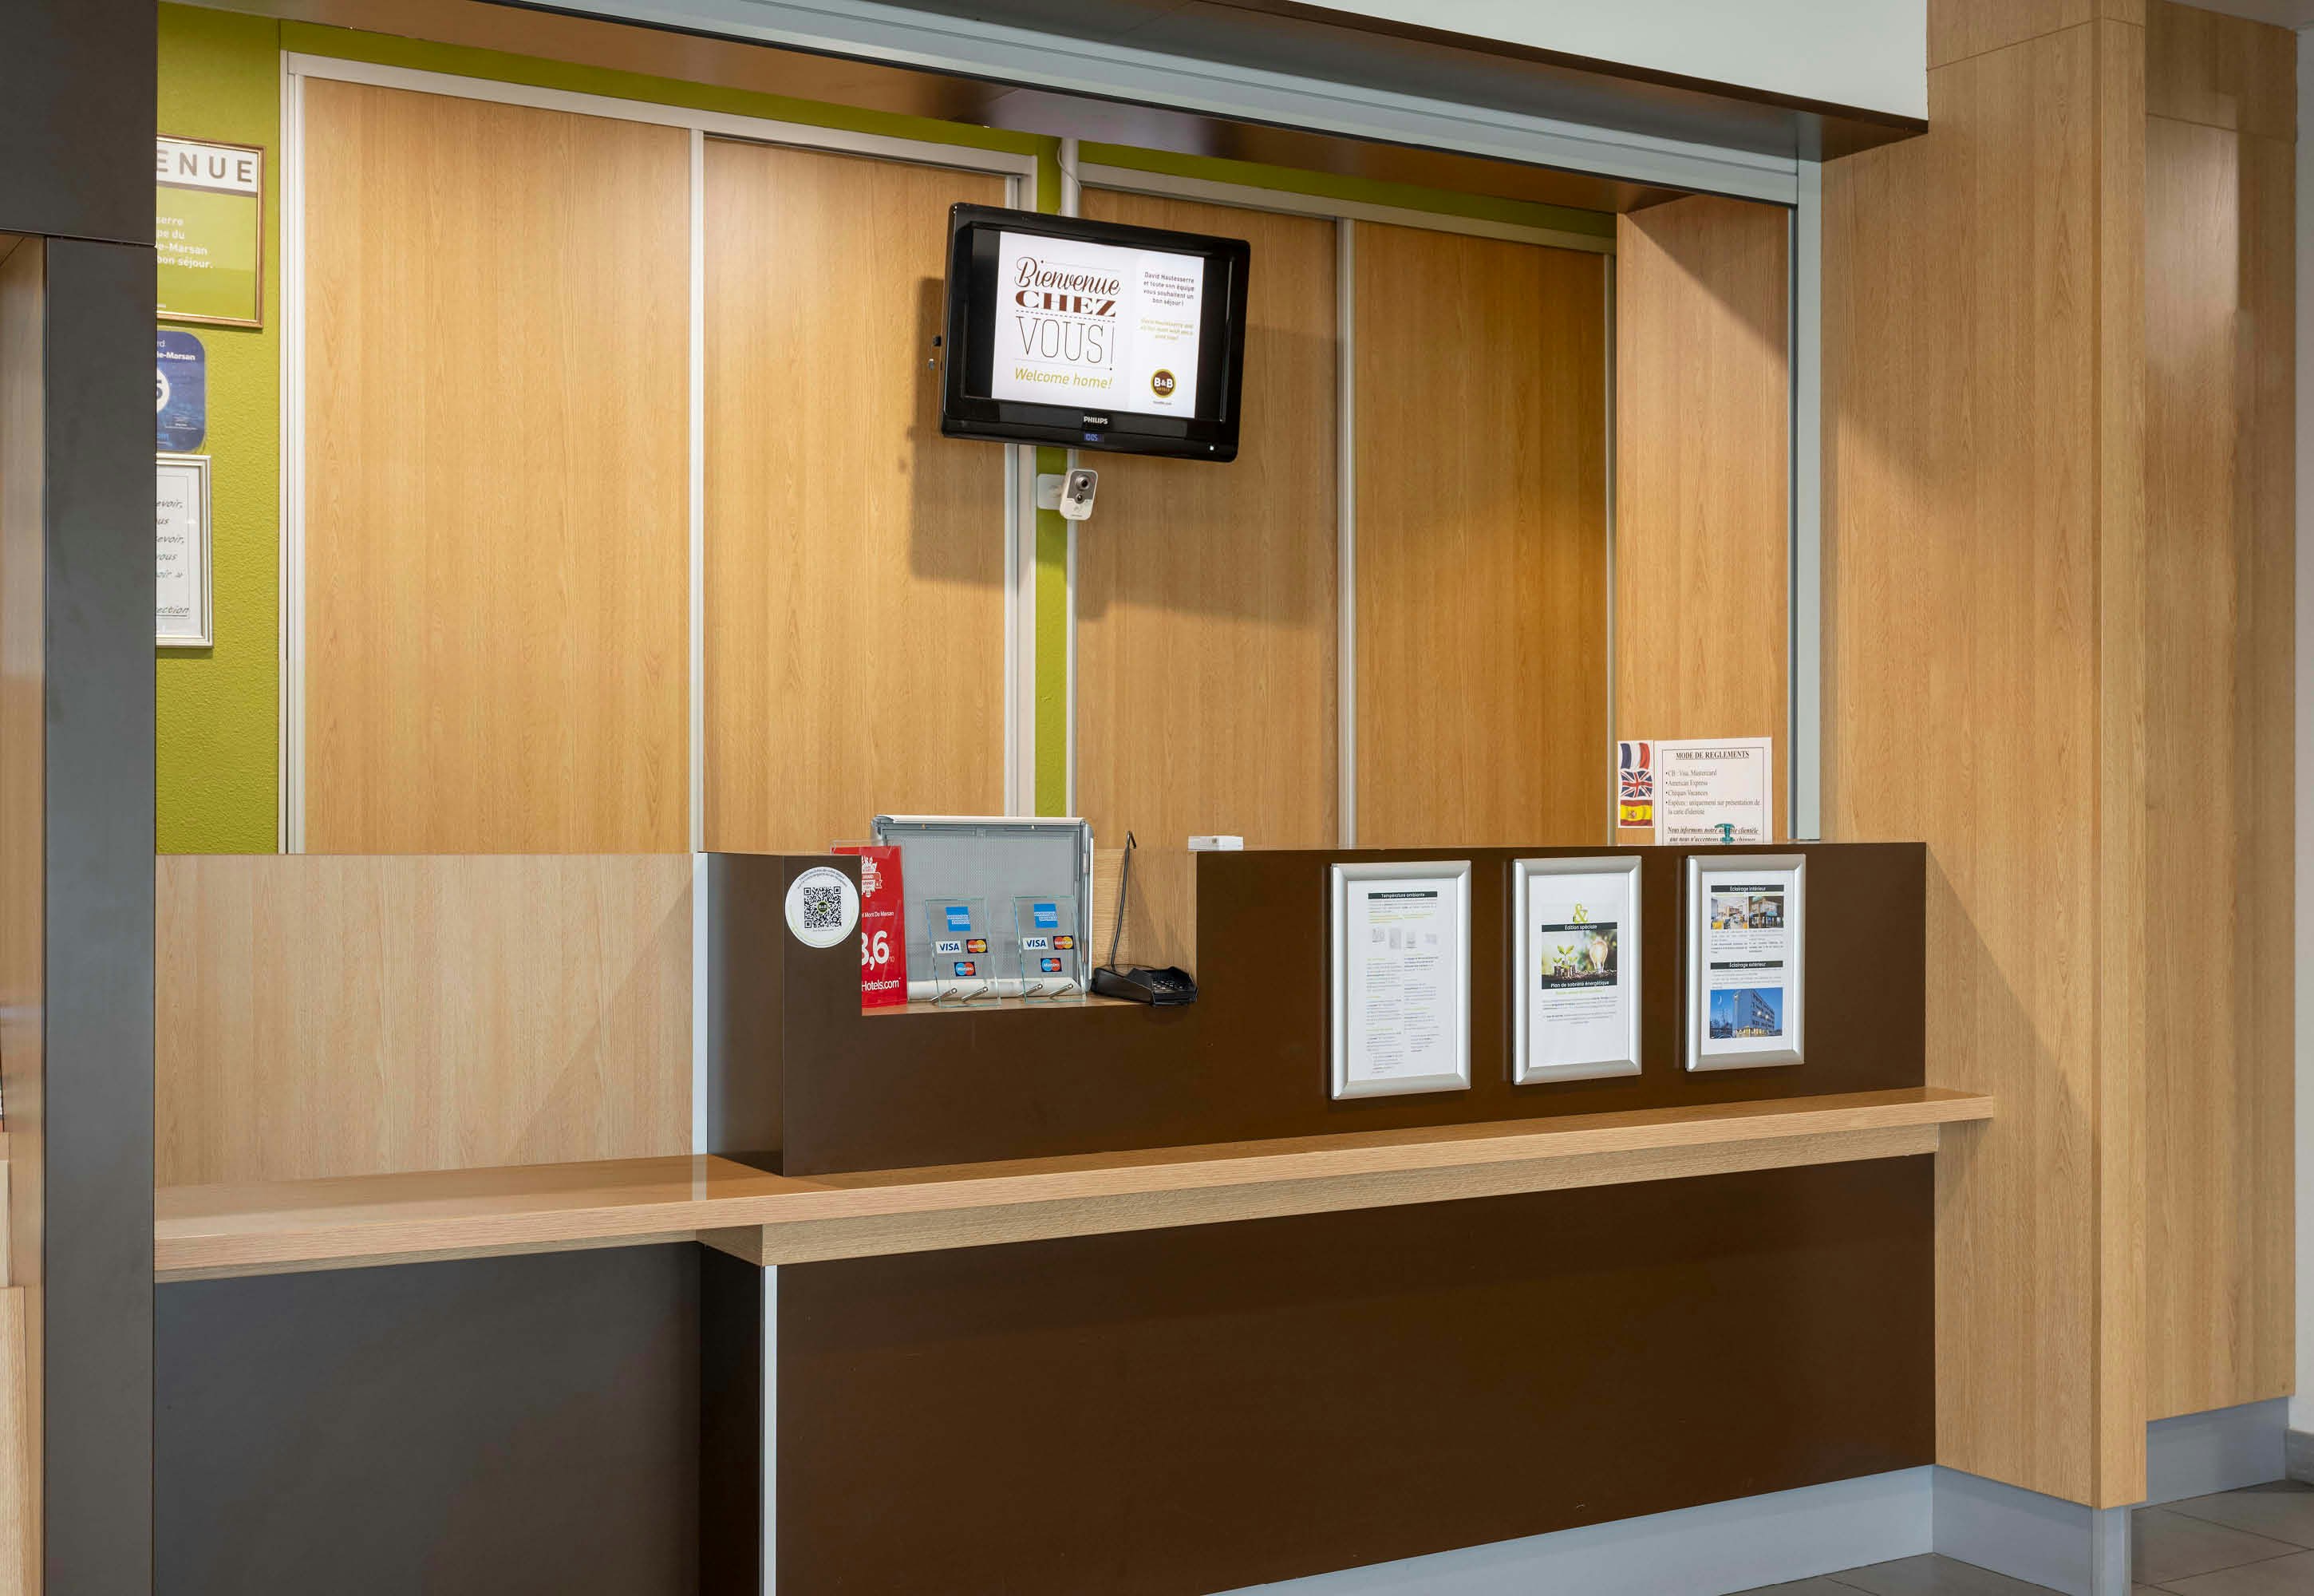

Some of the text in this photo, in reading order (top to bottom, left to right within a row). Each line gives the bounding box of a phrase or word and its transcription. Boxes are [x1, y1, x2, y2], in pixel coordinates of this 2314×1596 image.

[172, 229, 184, 239] du
[156, 242, 207, 255] e-Marsan
[157, 255, 214, 268] bon séjour.
[1014, 256, 1121, 296] Bienvenue
[1015, 290, 1116, 318] CHEZ
[1014, 366, 1113, 389] Welcome home!
[1154, 377, 1173, 389] B&B
[1084, 416, 1108, 425] PHILIPS
[1705, 750, 1750, 759] REGLEMENTS
[1725, 798, 1753, 808] présentation
[862, 979, 899, 991] Hotels.com
